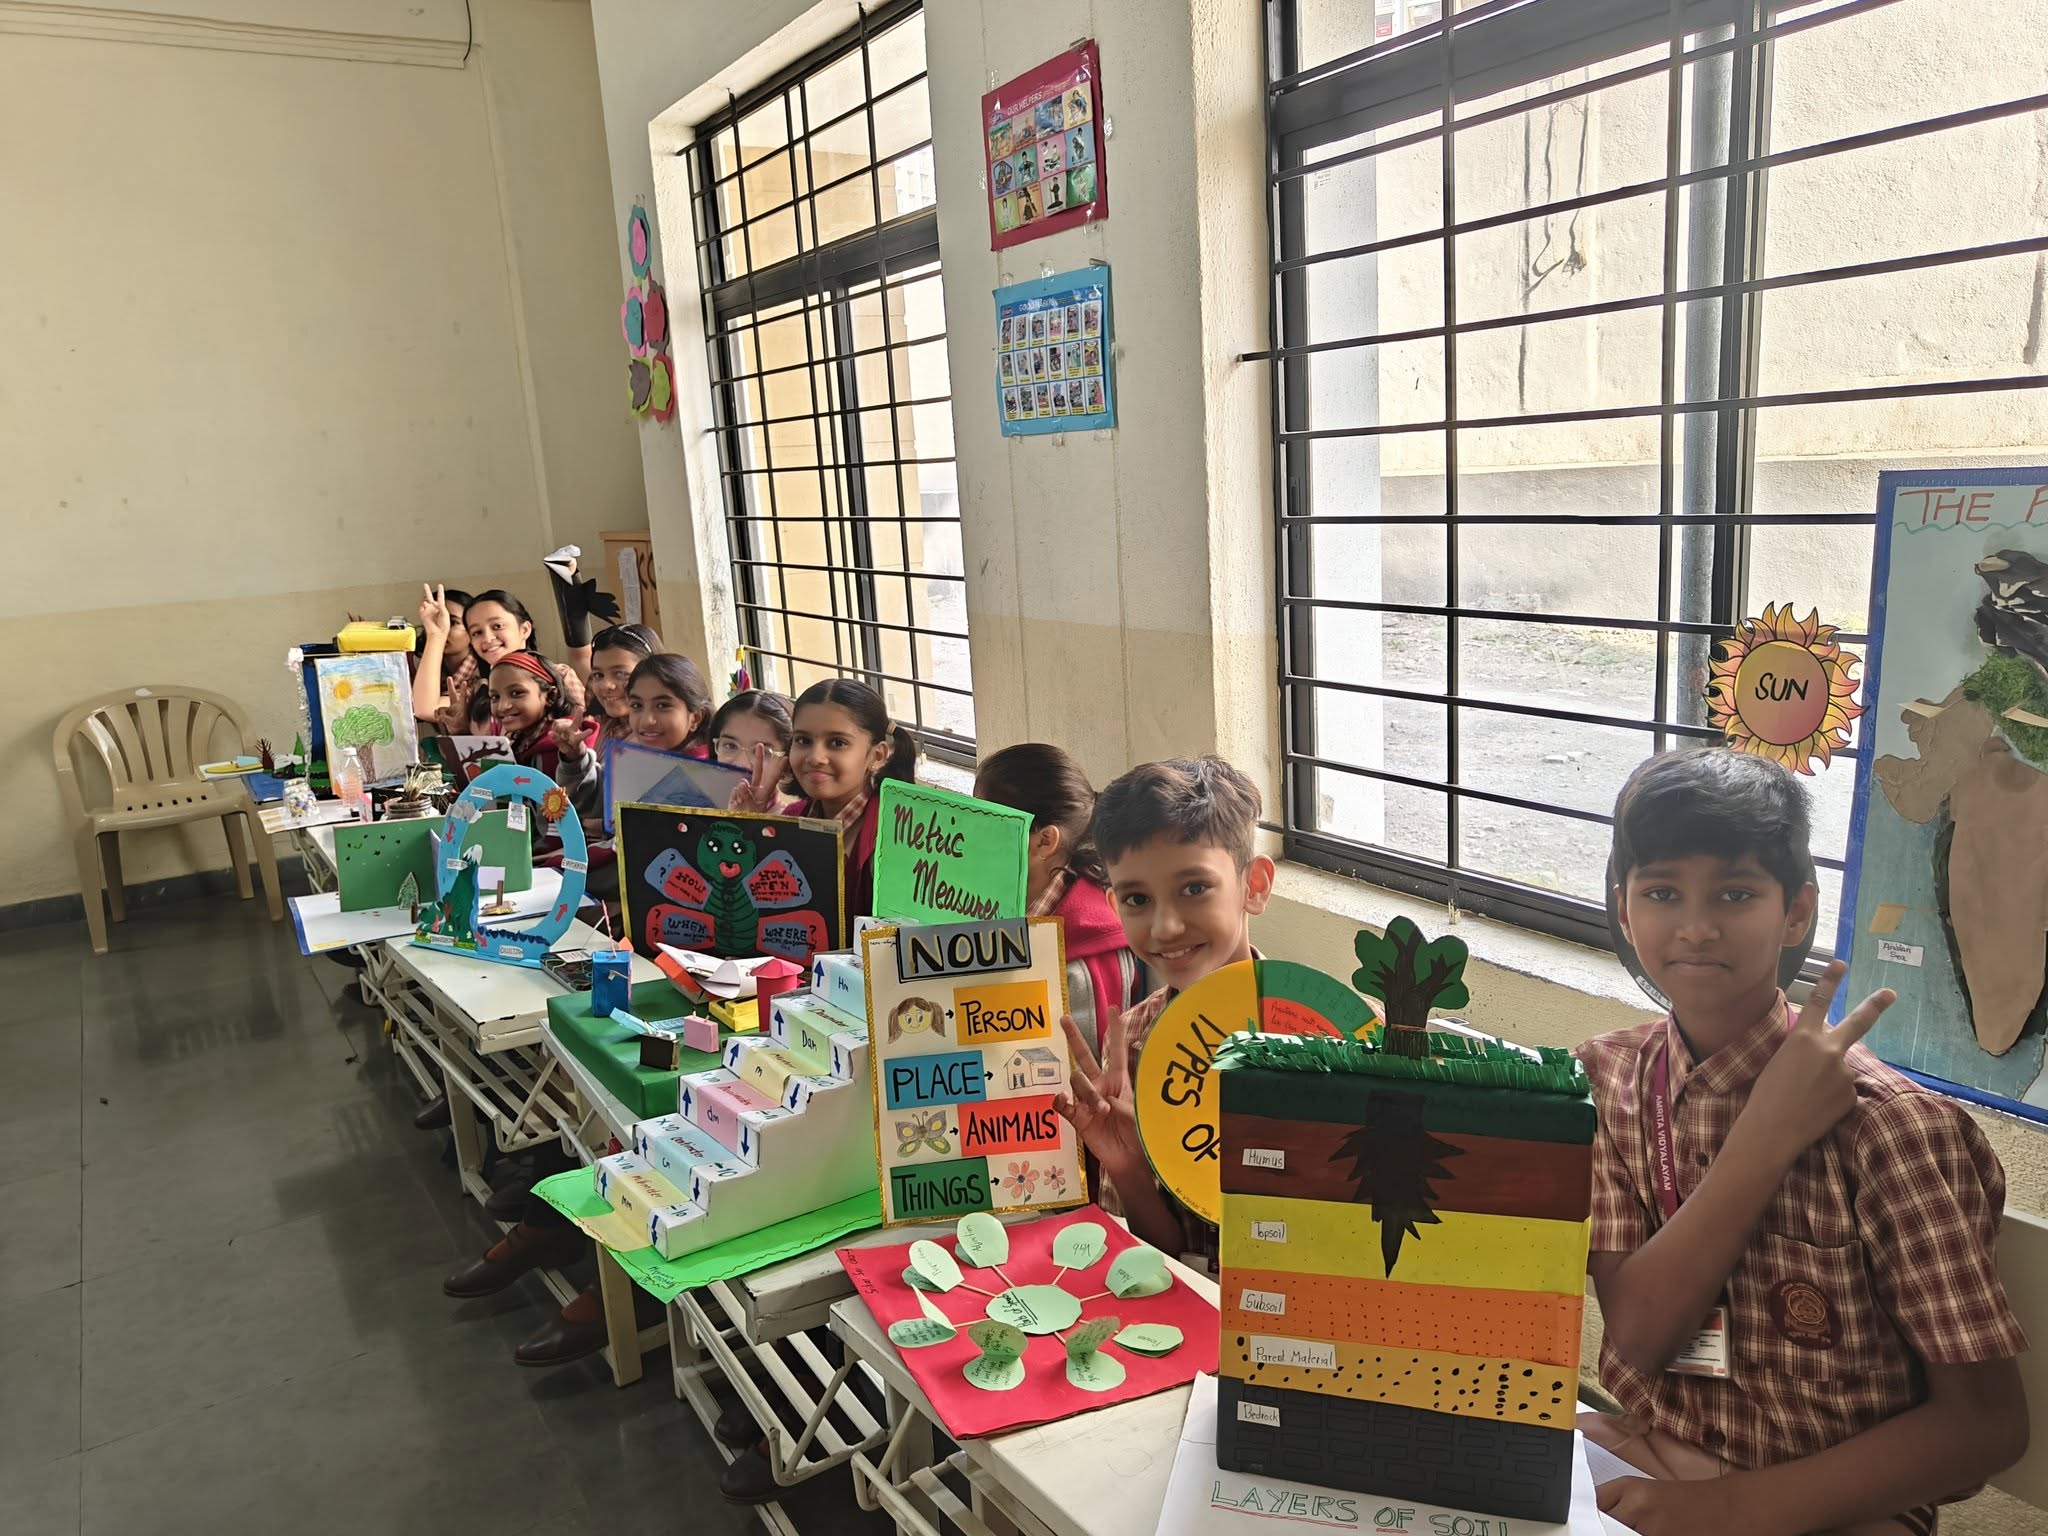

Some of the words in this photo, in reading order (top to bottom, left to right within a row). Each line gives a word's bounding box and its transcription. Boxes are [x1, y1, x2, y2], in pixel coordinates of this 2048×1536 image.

[1008, 103, 1019, 115] OUR
[1020, 91, 1042, 110] HELPERS
[1899, 488, 1995, 525] THE
[1755, 672, 1809, 701] SUN
[894, 803, 965, 858] Metric
[675, 872, 706, 893] HOW
[759, 870, 787, 881] HOW
[668, 917, 707, 934] WHEN
[765, 927, 808, 941] WHERE
[909, 927, 1029, 975] NOUN
[1883, 943, 1911, 954] Arabian
[1890, 951, 1907, 961] Sea
[960, 1000, 1045, 1036] PERSON
[893, 1061, 980, 1102] PLACE
[1656, 1094, 1666, 1130] AMRITA
[966, 1109, 1057, 1147] ANIMALS
[1248, 1153, 1283, 1168] Humus
[1657, 1130, 1672, 1191] VIDYALAYAM
[892, 1172, 984, 1212] THINGS
[1254, 1221, 1285, 1240] Topsoil
[1072, 1243, 1091, 1257] Verb
[1246, 1294, 1283, 1313] Subsoil
[1256, 1346, 1286, 1362] Parent
[1291, 1348, 1334, 1367] Material
[1244, 1404, 1279, 1421] Bedrock
[1211, 1480, 1359, 1523] LAYERS
[1373, 1506, 1416, 1529] OF
